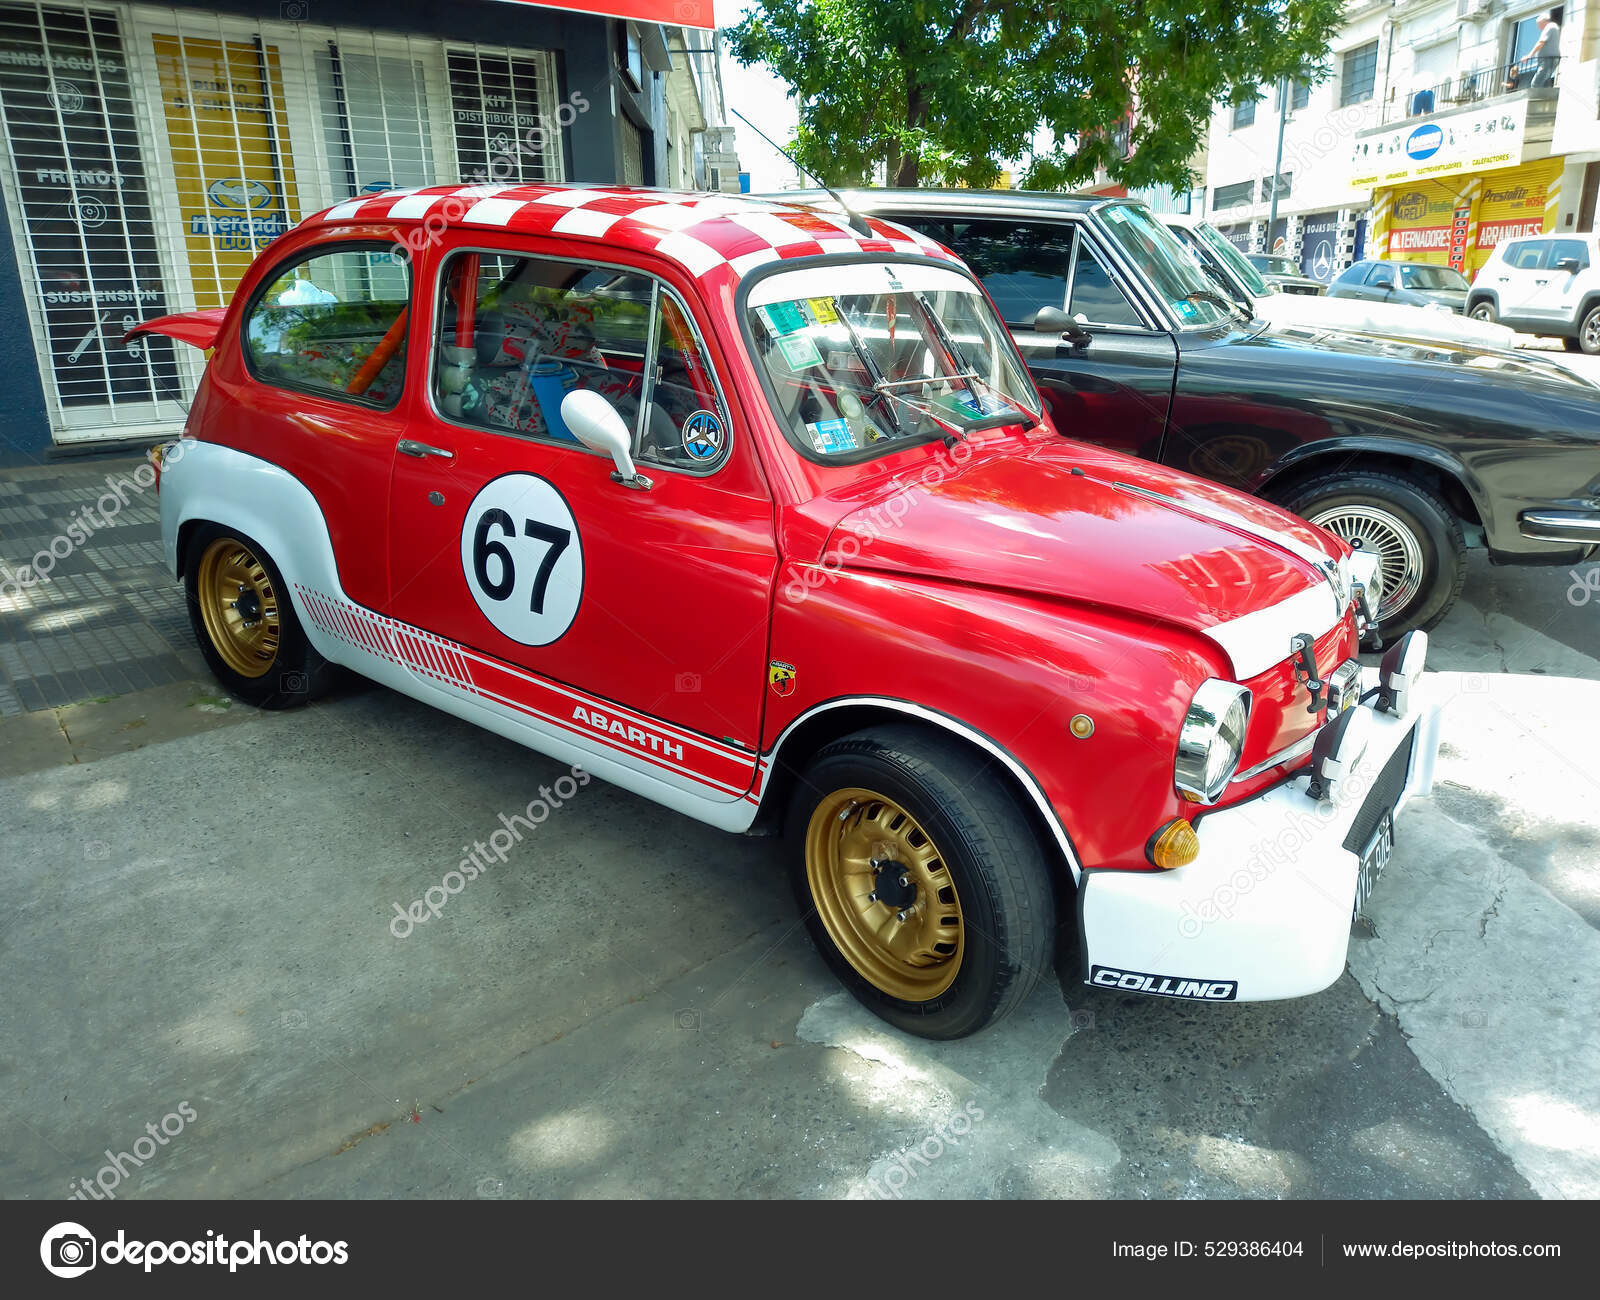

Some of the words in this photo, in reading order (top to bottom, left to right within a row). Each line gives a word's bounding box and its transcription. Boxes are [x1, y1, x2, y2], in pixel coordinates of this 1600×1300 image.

[202, 98, 268, 114] ENTREG
[483, 94, 507, 108] KIT
[457, 112, 535, 126] DISTRIBUCON
[1472, 153, 1509, 167] CALEFACTORES
[35, 168, 124, 186] FRENOS
[1390, 229, 1451, 249] ALTERNADORES
[473, 508, 571, 615] 67
[572, 706, 684, 761] ABARTH
[1093, 970, 1234, 999] COLLINO
